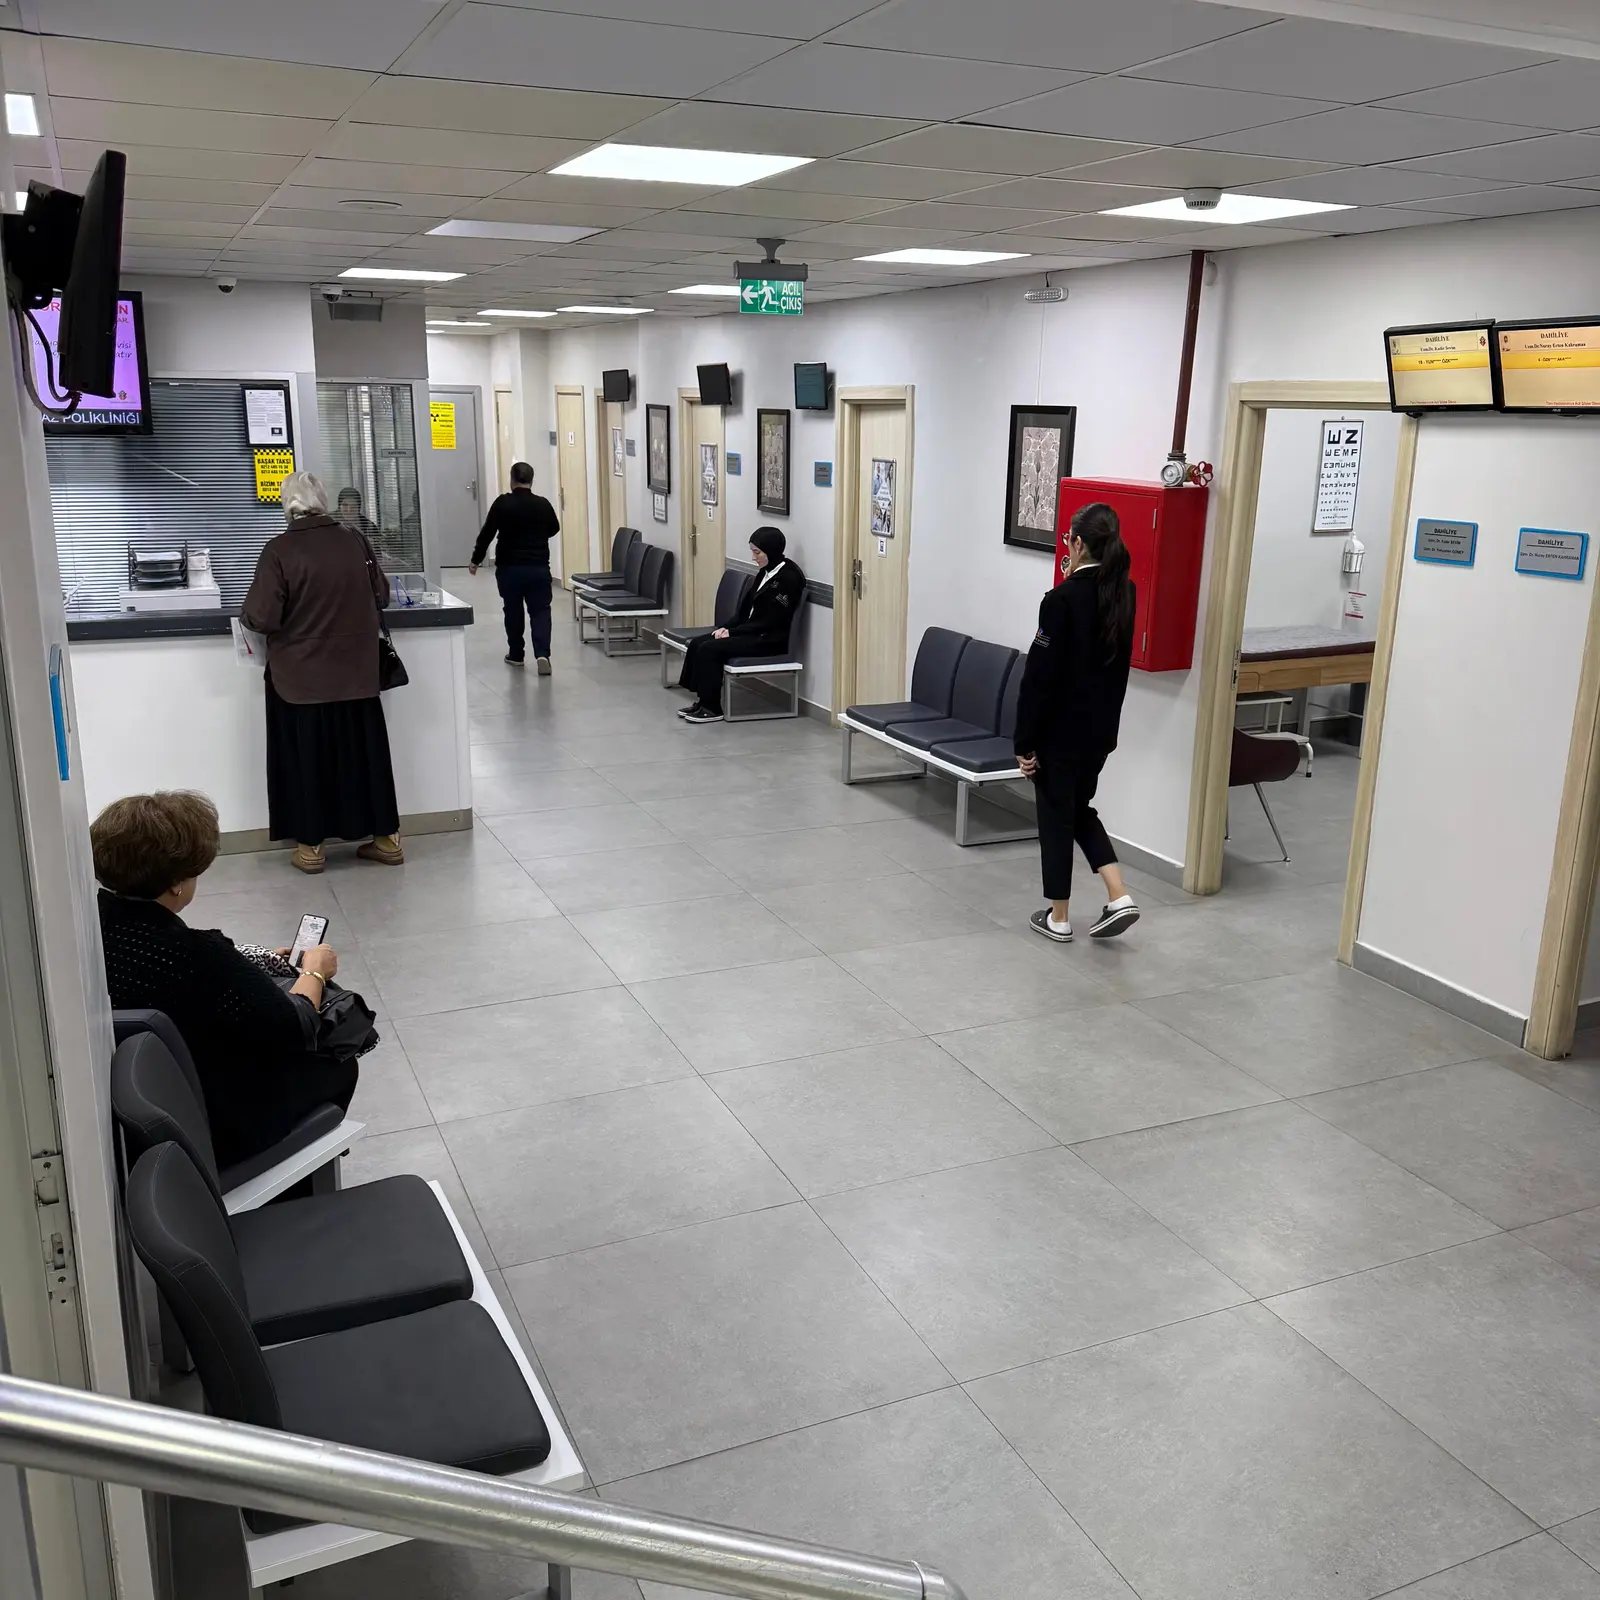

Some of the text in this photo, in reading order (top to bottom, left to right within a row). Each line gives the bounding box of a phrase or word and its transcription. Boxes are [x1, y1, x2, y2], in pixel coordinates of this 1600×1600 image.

[782, 281, 801, 296] ACİL
[780, 296, 802, 314] ÇIKIŞ
[1425, 335, 1450, 343] DAHİLİYE
[1540, 331, 1569, 339] DAHİLİYE
[1537, 539, 1564, 547] DAHİLİYE
